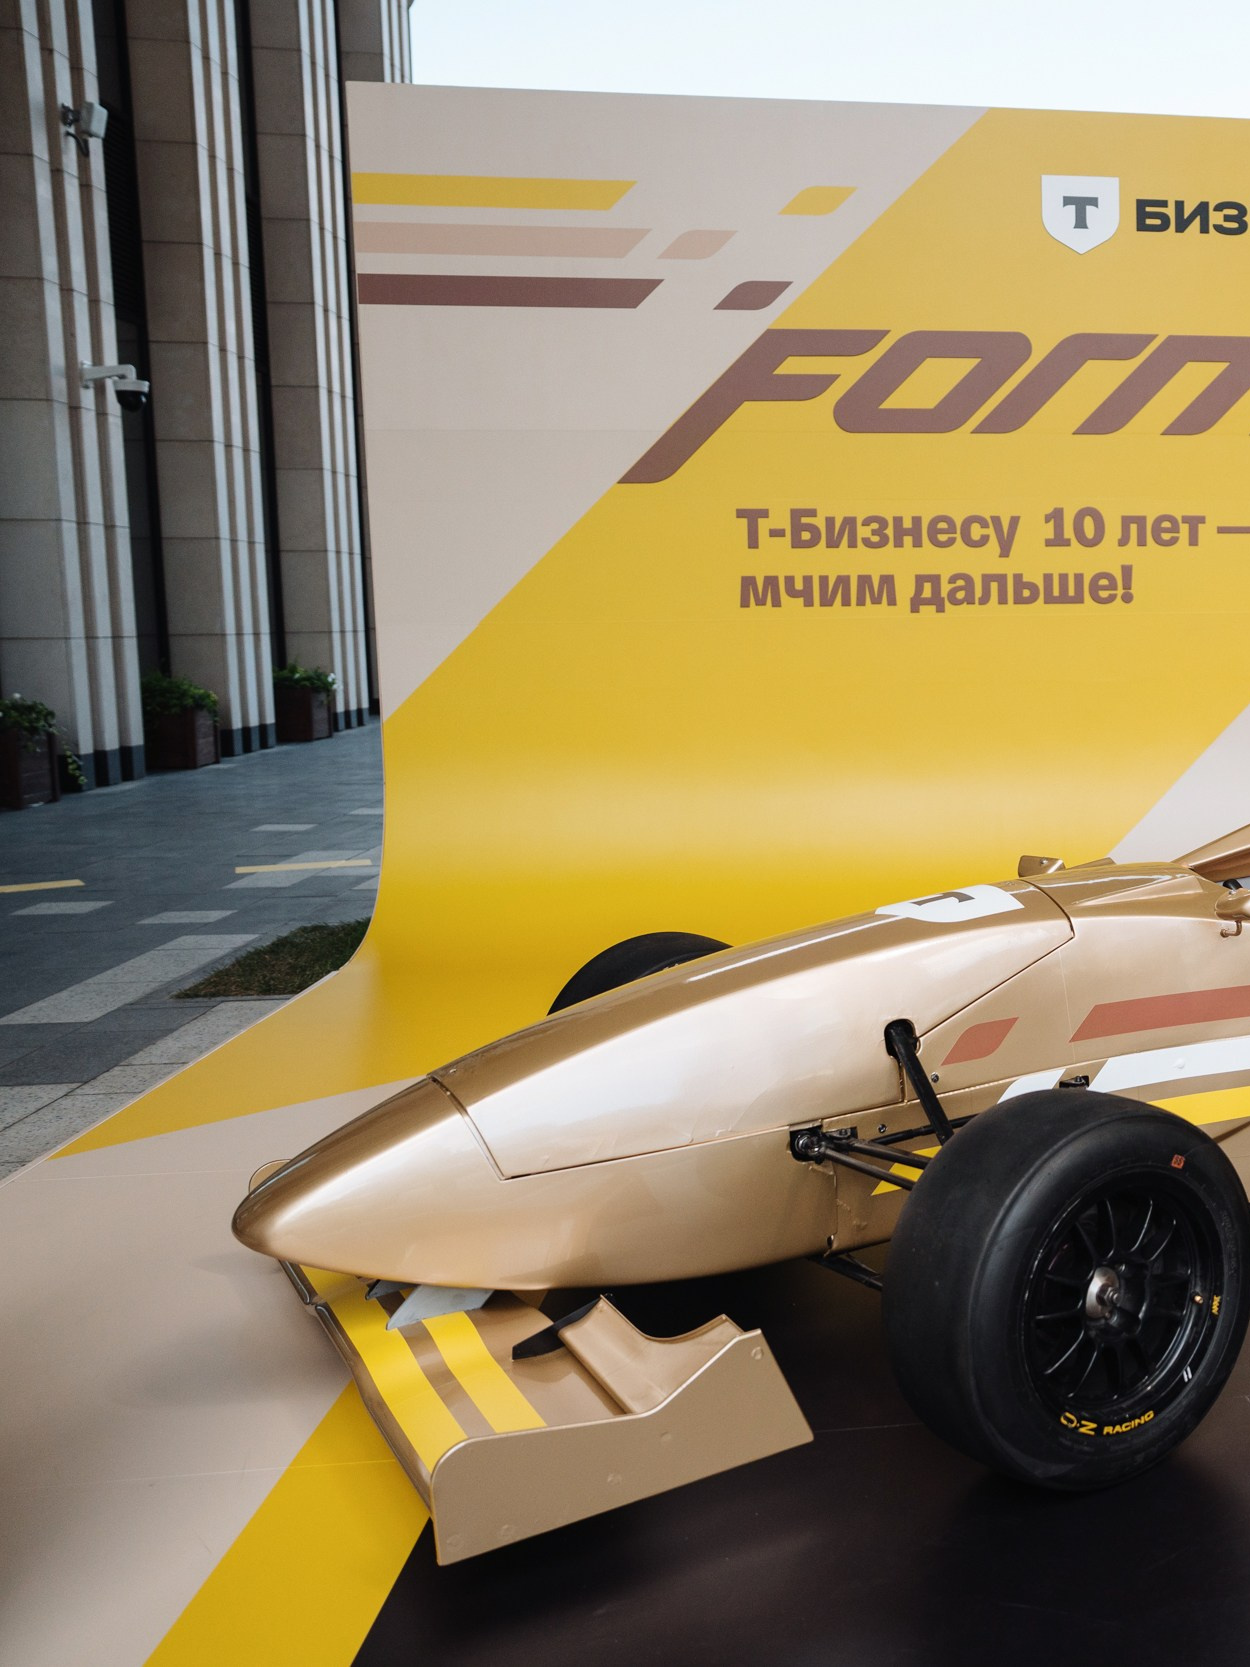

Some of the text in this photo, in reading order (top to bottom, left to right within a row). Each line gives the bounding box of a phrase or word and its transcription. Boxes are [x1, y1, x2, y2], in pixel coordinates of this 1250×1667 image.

[736, 508, 1021, 558] Т-Бизнесу
[1044, 506, 1106, 548] 10
[1117, 513, 1206, 547] лет
[739, 563, 1135, 614] мчим дальше!
[1103, 1410, 1155, 1436] RACING
